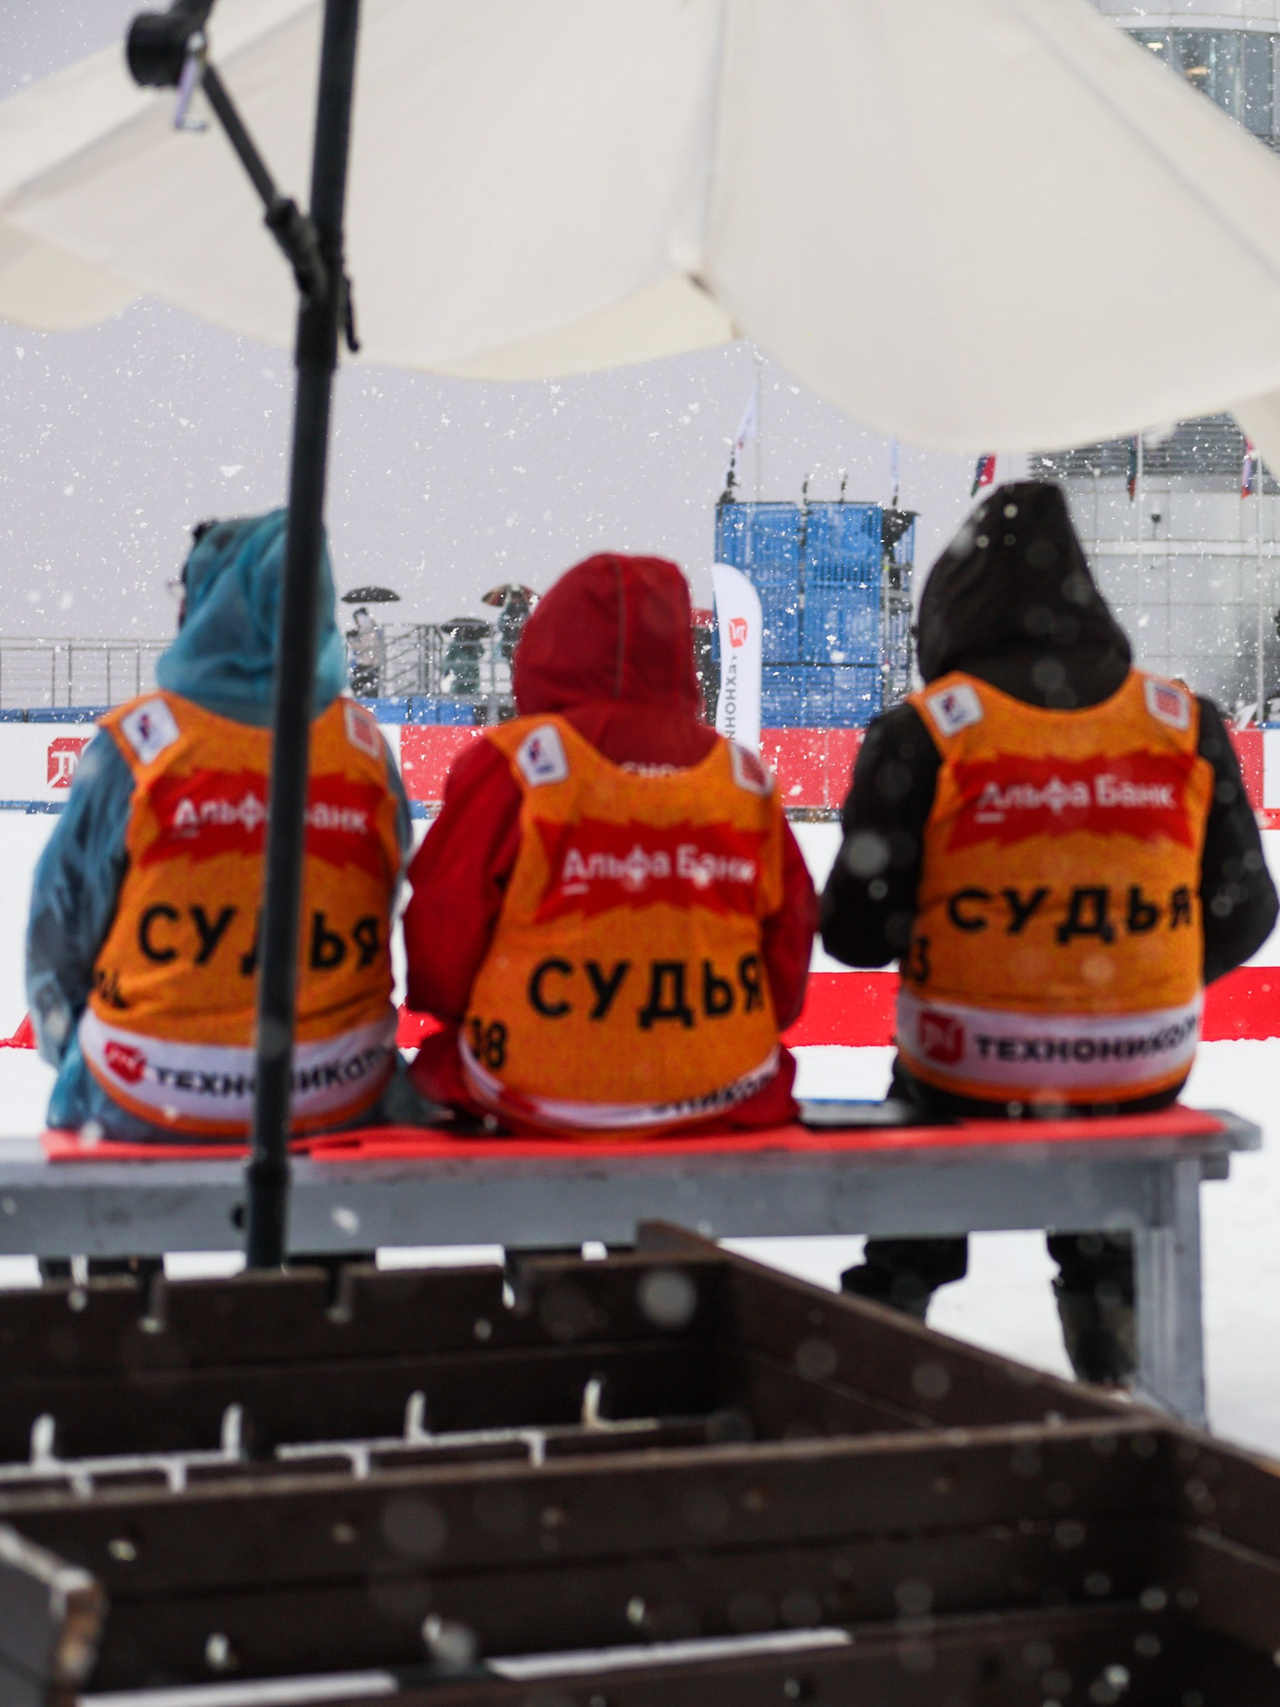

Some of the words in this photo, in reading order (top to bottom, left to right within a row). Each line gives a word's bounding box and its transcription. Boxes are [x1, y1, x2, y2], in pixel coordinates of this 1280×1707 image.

[172, 791, 269, 833] Альф
[303, 799, 369, 832] анк
[976, 774, 1090, 816] Альфа
[1095, 772, 1174, 811] Банк
[563, 843, 670, 888] Альфа
[676, 845, 757, 885] Банк
[947, 882, 1194, 946] СУДЬЯ
[527, 951, 765, 1032] СУДЬЯ
